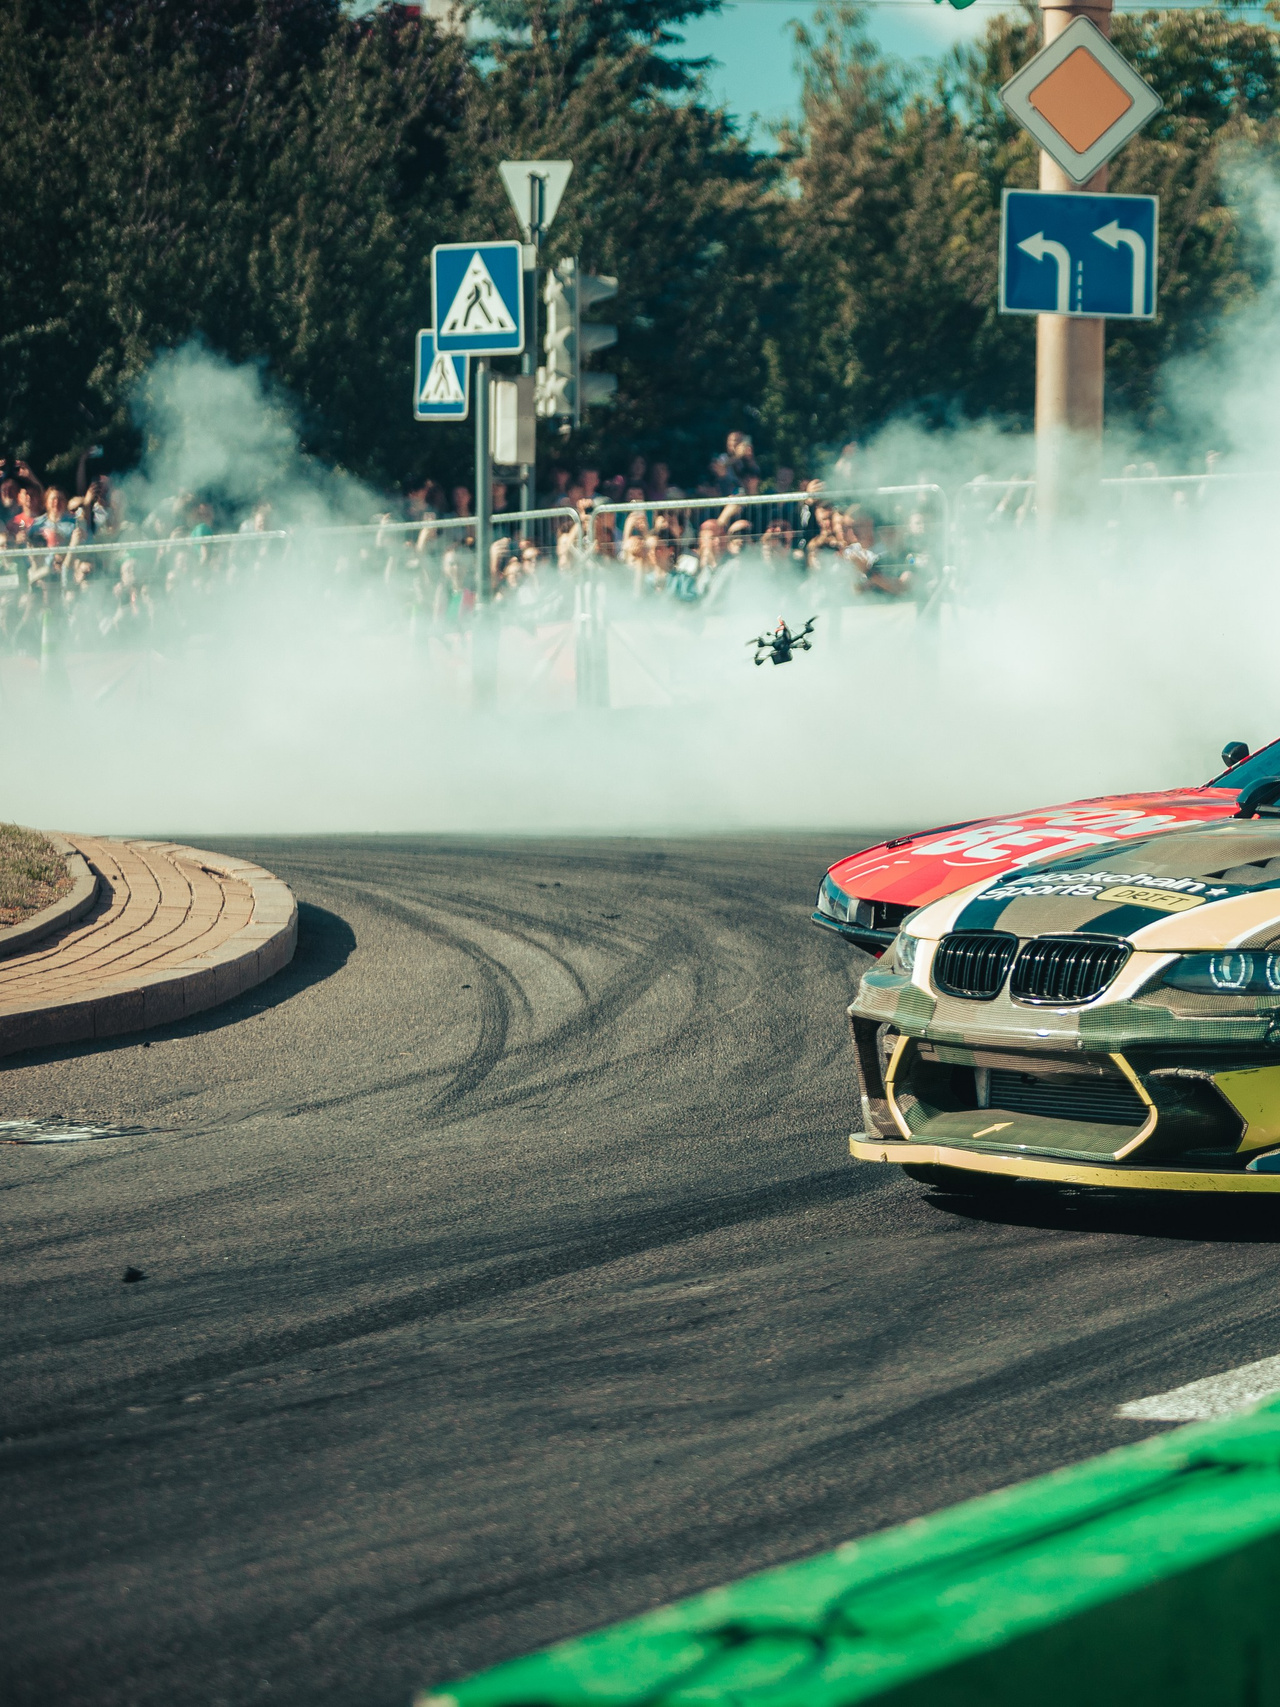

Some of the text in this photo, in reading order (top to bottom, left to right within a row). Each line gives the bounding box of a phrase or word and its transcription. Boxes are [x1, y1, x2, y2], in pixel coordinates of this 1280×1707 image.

[996, 807, 1206, 836] FON
[911, 824, 1121, 866] BET
[977, 883, 1190, 908] Sports DRIFT
[1003, 871, 1207, 895] Blockchain
